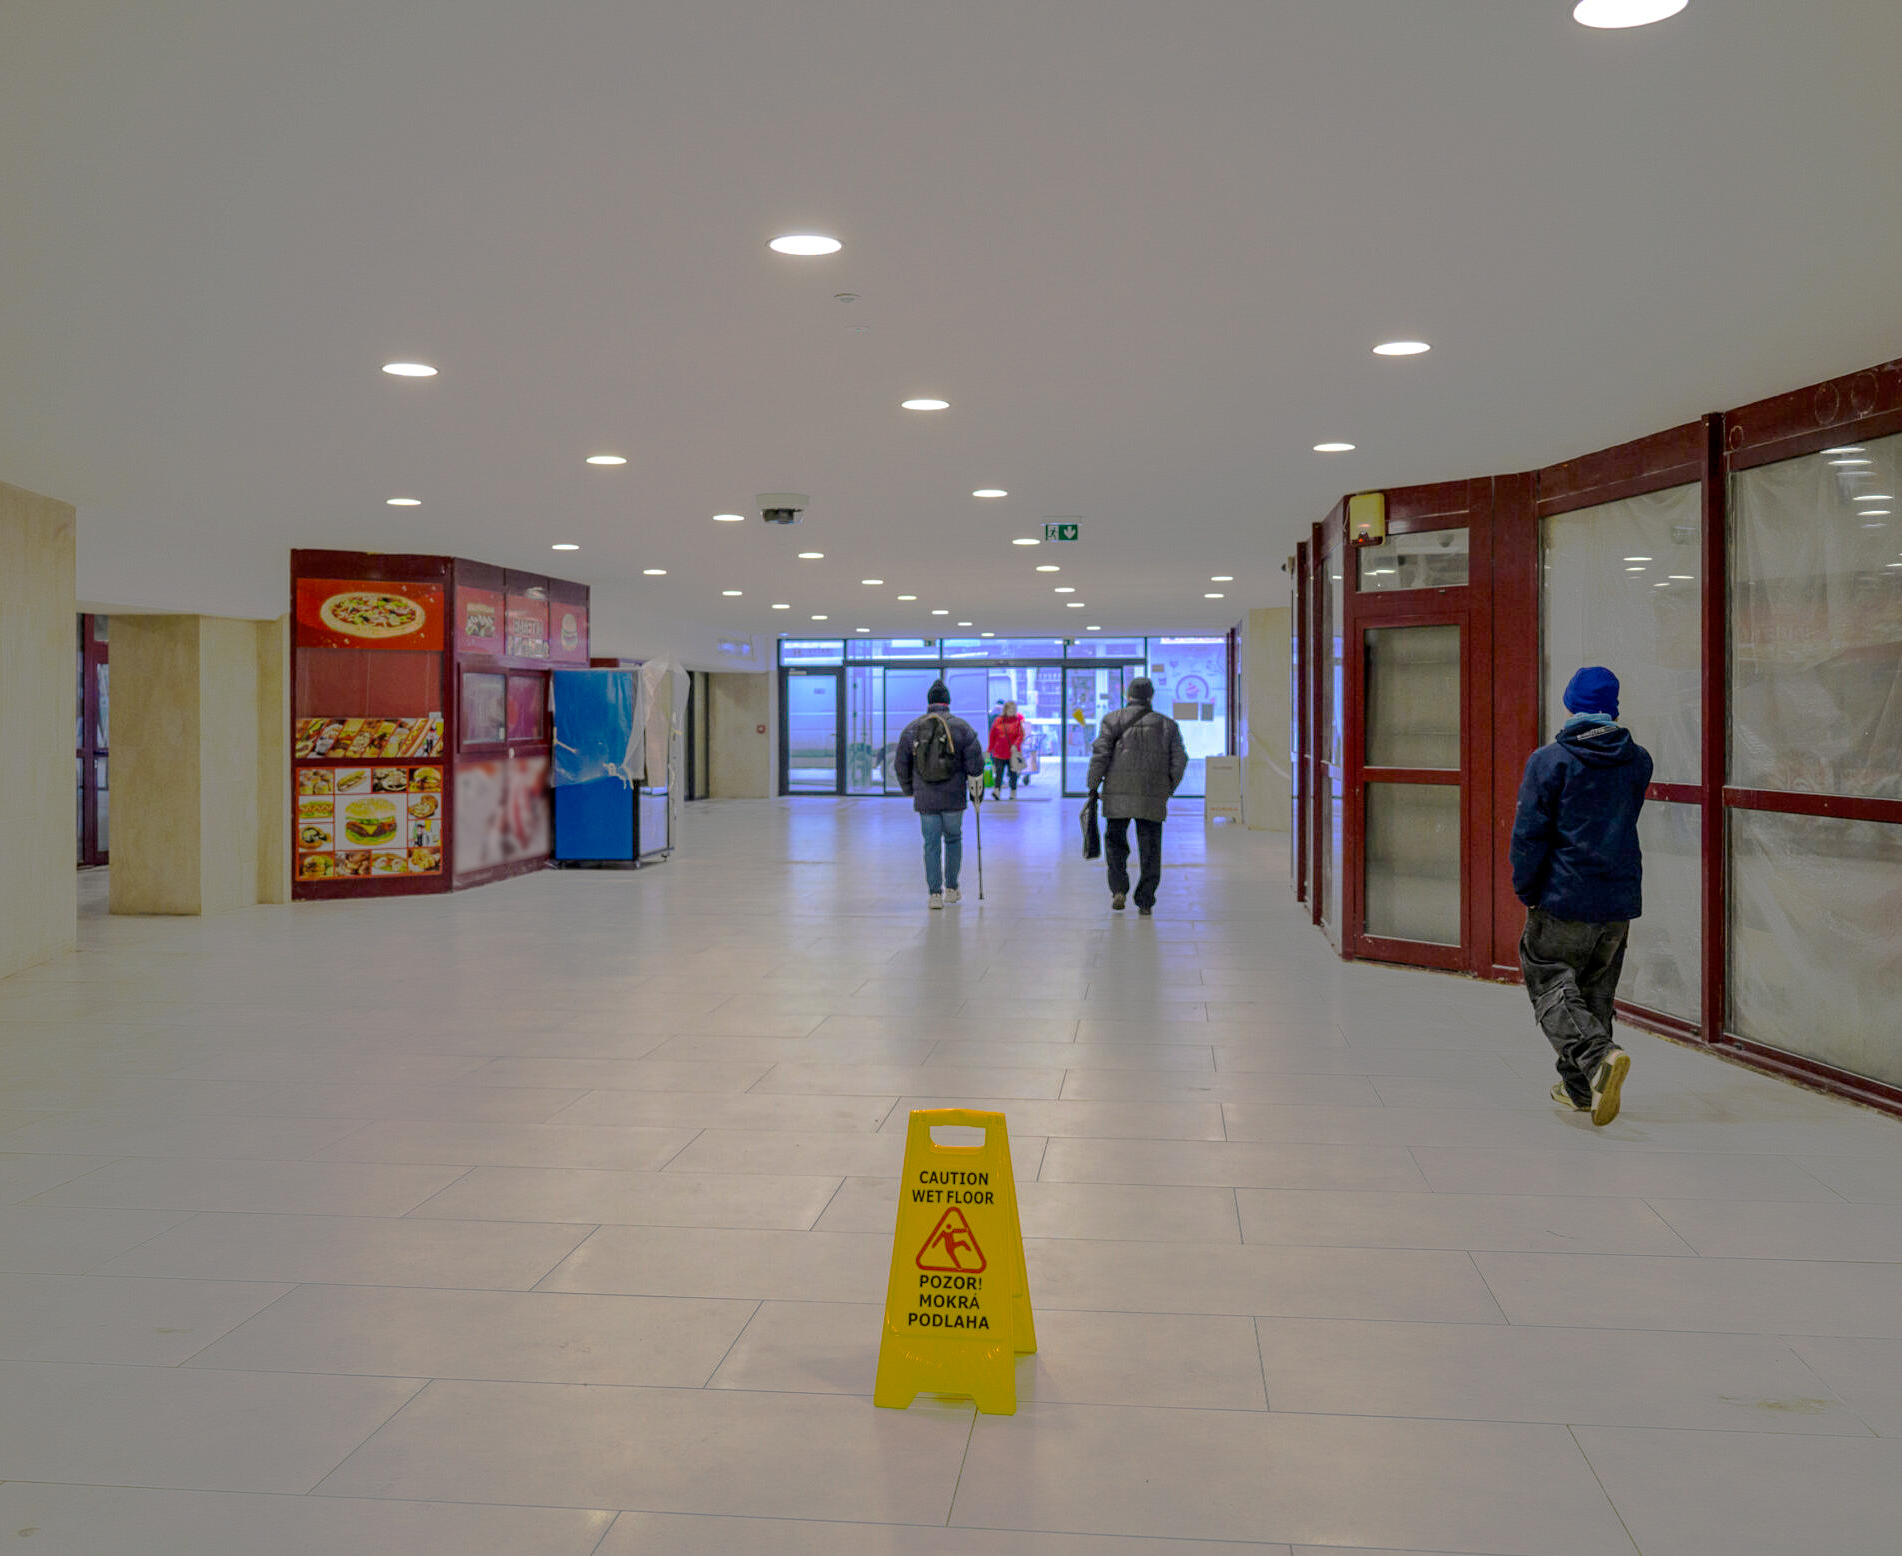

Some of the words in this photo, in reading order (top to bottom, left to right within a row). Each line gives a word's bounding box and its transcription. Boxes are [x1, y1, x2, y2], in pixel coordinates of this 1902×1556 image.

[919, 1170, 989, 1186] CAUTION
[912, 1189, 943, 1203] WET
[946, 1190, 994, 1205] FLOOR
[919, 1274, 983, 1291] POZOR!
[919, 1293, 980, 1310] MOKRÁ
[908, 1312, 990, 1330] PODLAHA
